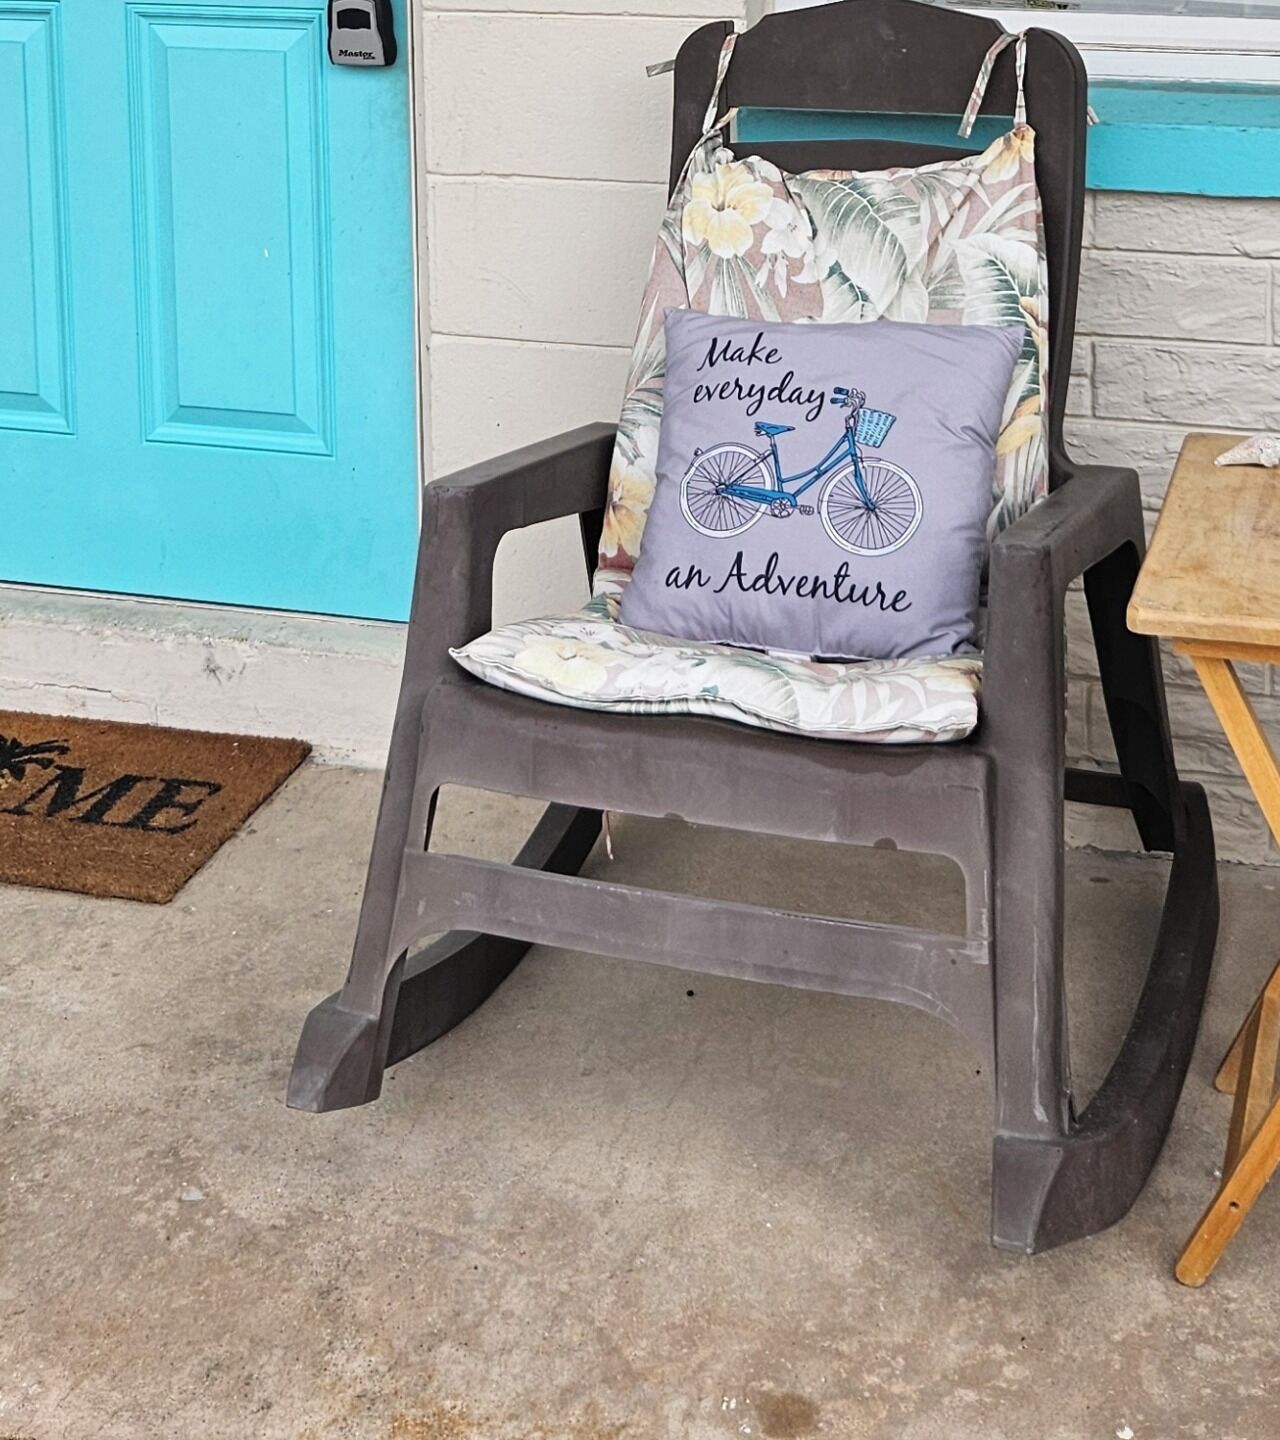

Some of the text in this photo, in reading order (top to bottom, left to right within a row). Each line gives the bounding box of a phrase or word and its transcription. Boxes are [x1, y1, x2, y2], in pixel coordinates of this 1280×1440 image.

[696, 331, 783, 372] Make
[692, 371, 826, 422] everyday
[664, 550, 913, 614] an Adventure
